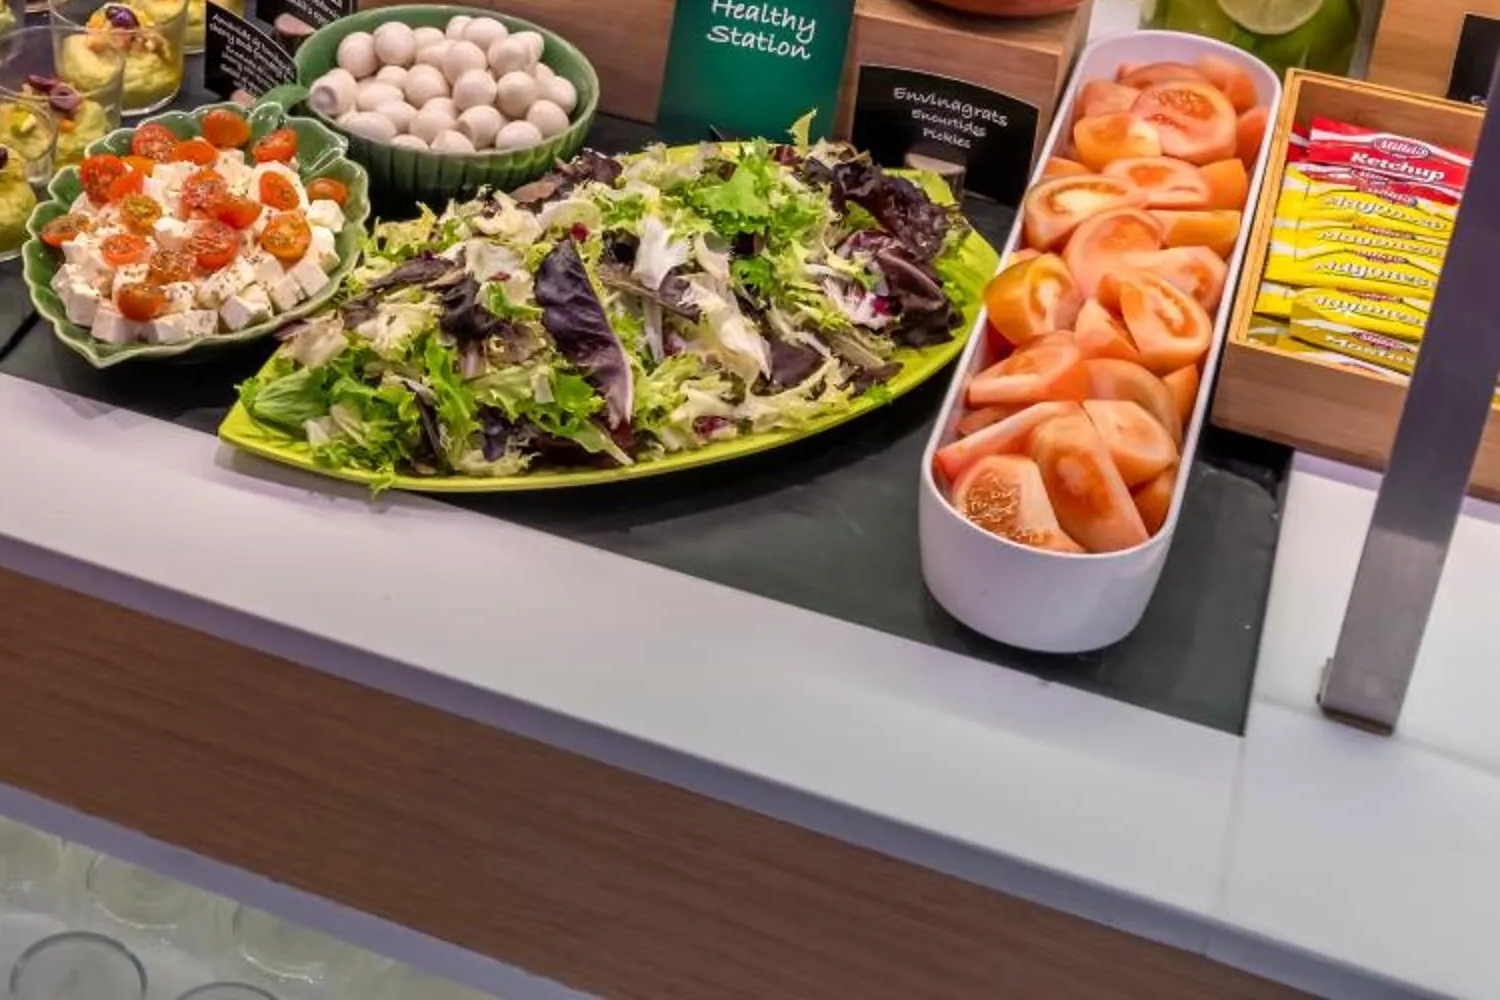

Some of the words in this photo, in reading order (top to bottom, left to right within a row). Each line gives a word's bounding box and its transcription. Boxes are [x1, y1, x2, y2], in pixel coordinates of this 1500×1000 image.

[706, 25, 812, 60] Station
[893, 87, 1008, 127] Envinagrats
[1351, 151, 1445, 183] Ketchup
